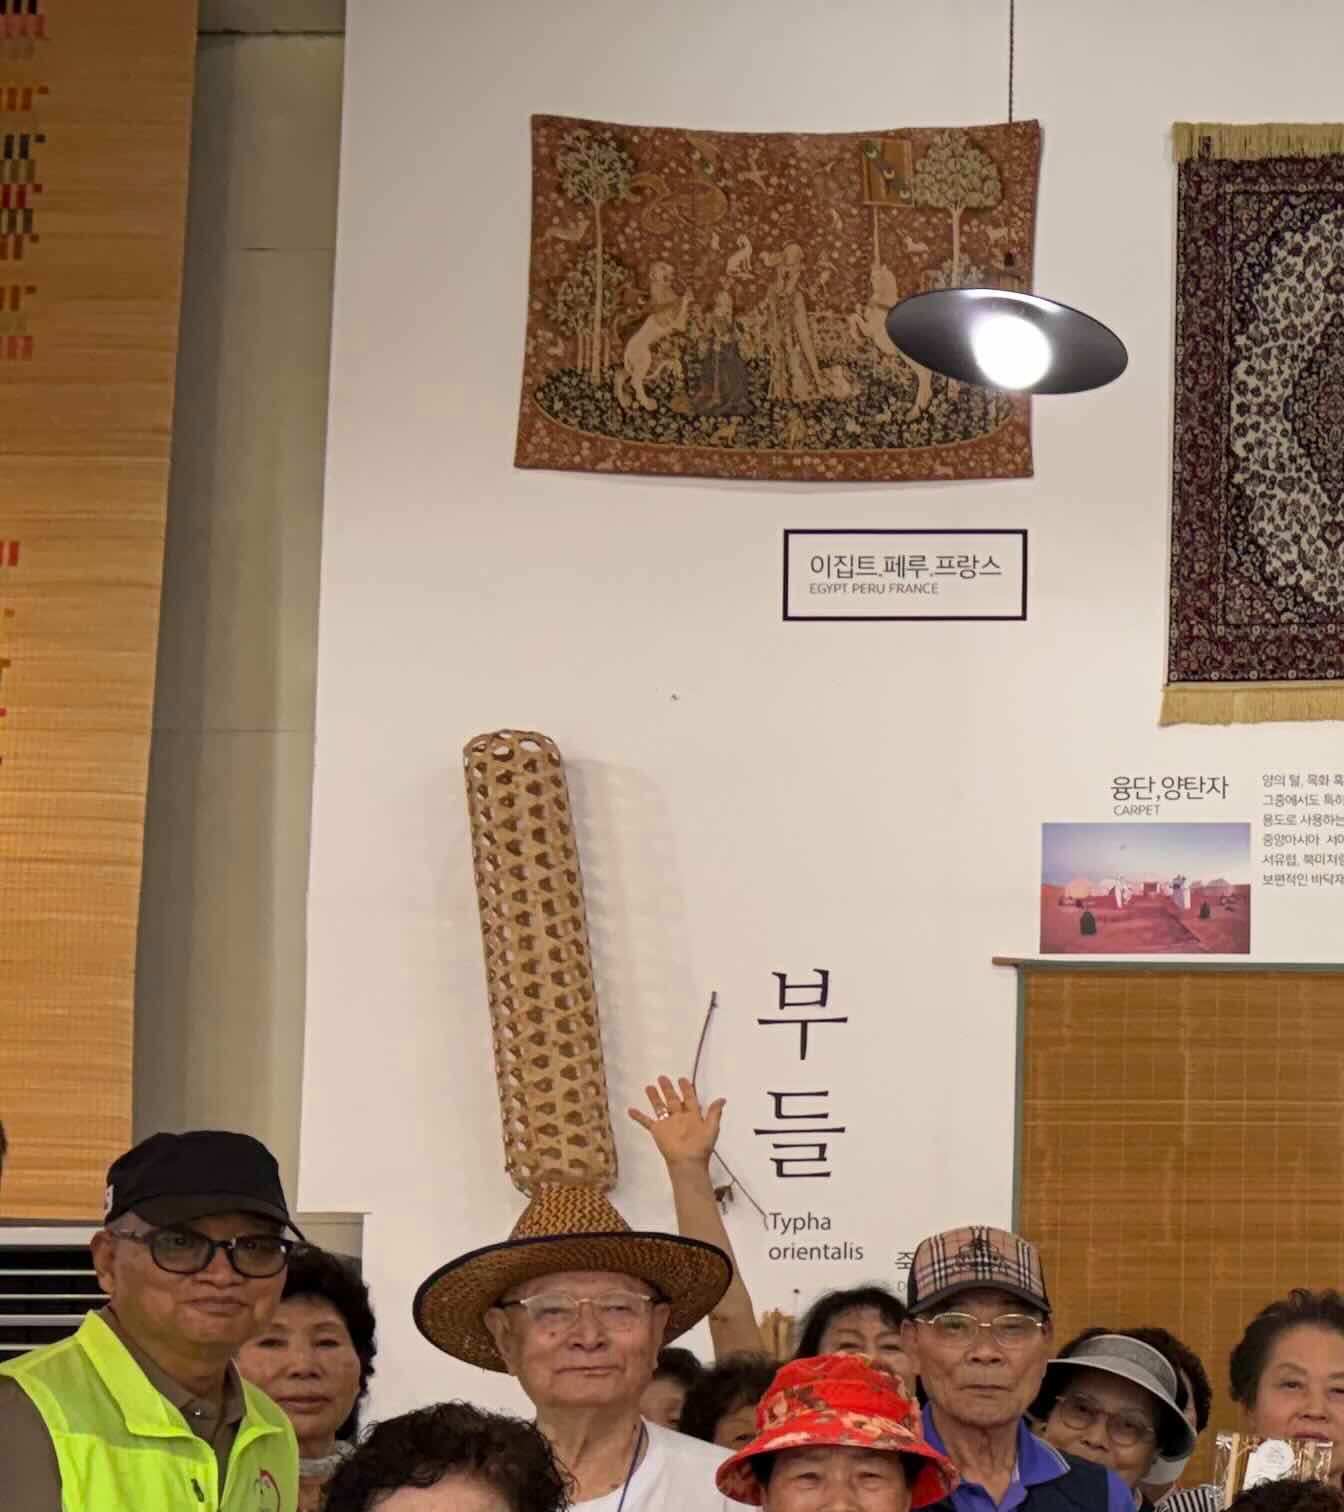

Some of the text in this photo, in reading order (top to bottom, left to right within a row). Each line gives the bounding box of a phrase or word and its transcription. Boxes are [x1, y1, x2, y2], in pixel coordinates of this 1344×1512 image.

[810, 583, 938, 594] EGYPT PERU FRANCE
[1113, 804, 1160, 816] CARPET
[754, 969, 848, 1178] 부들
[769, 1212, 831, 1235] Typha
[769, 1241, 863, 1260] orientalis
